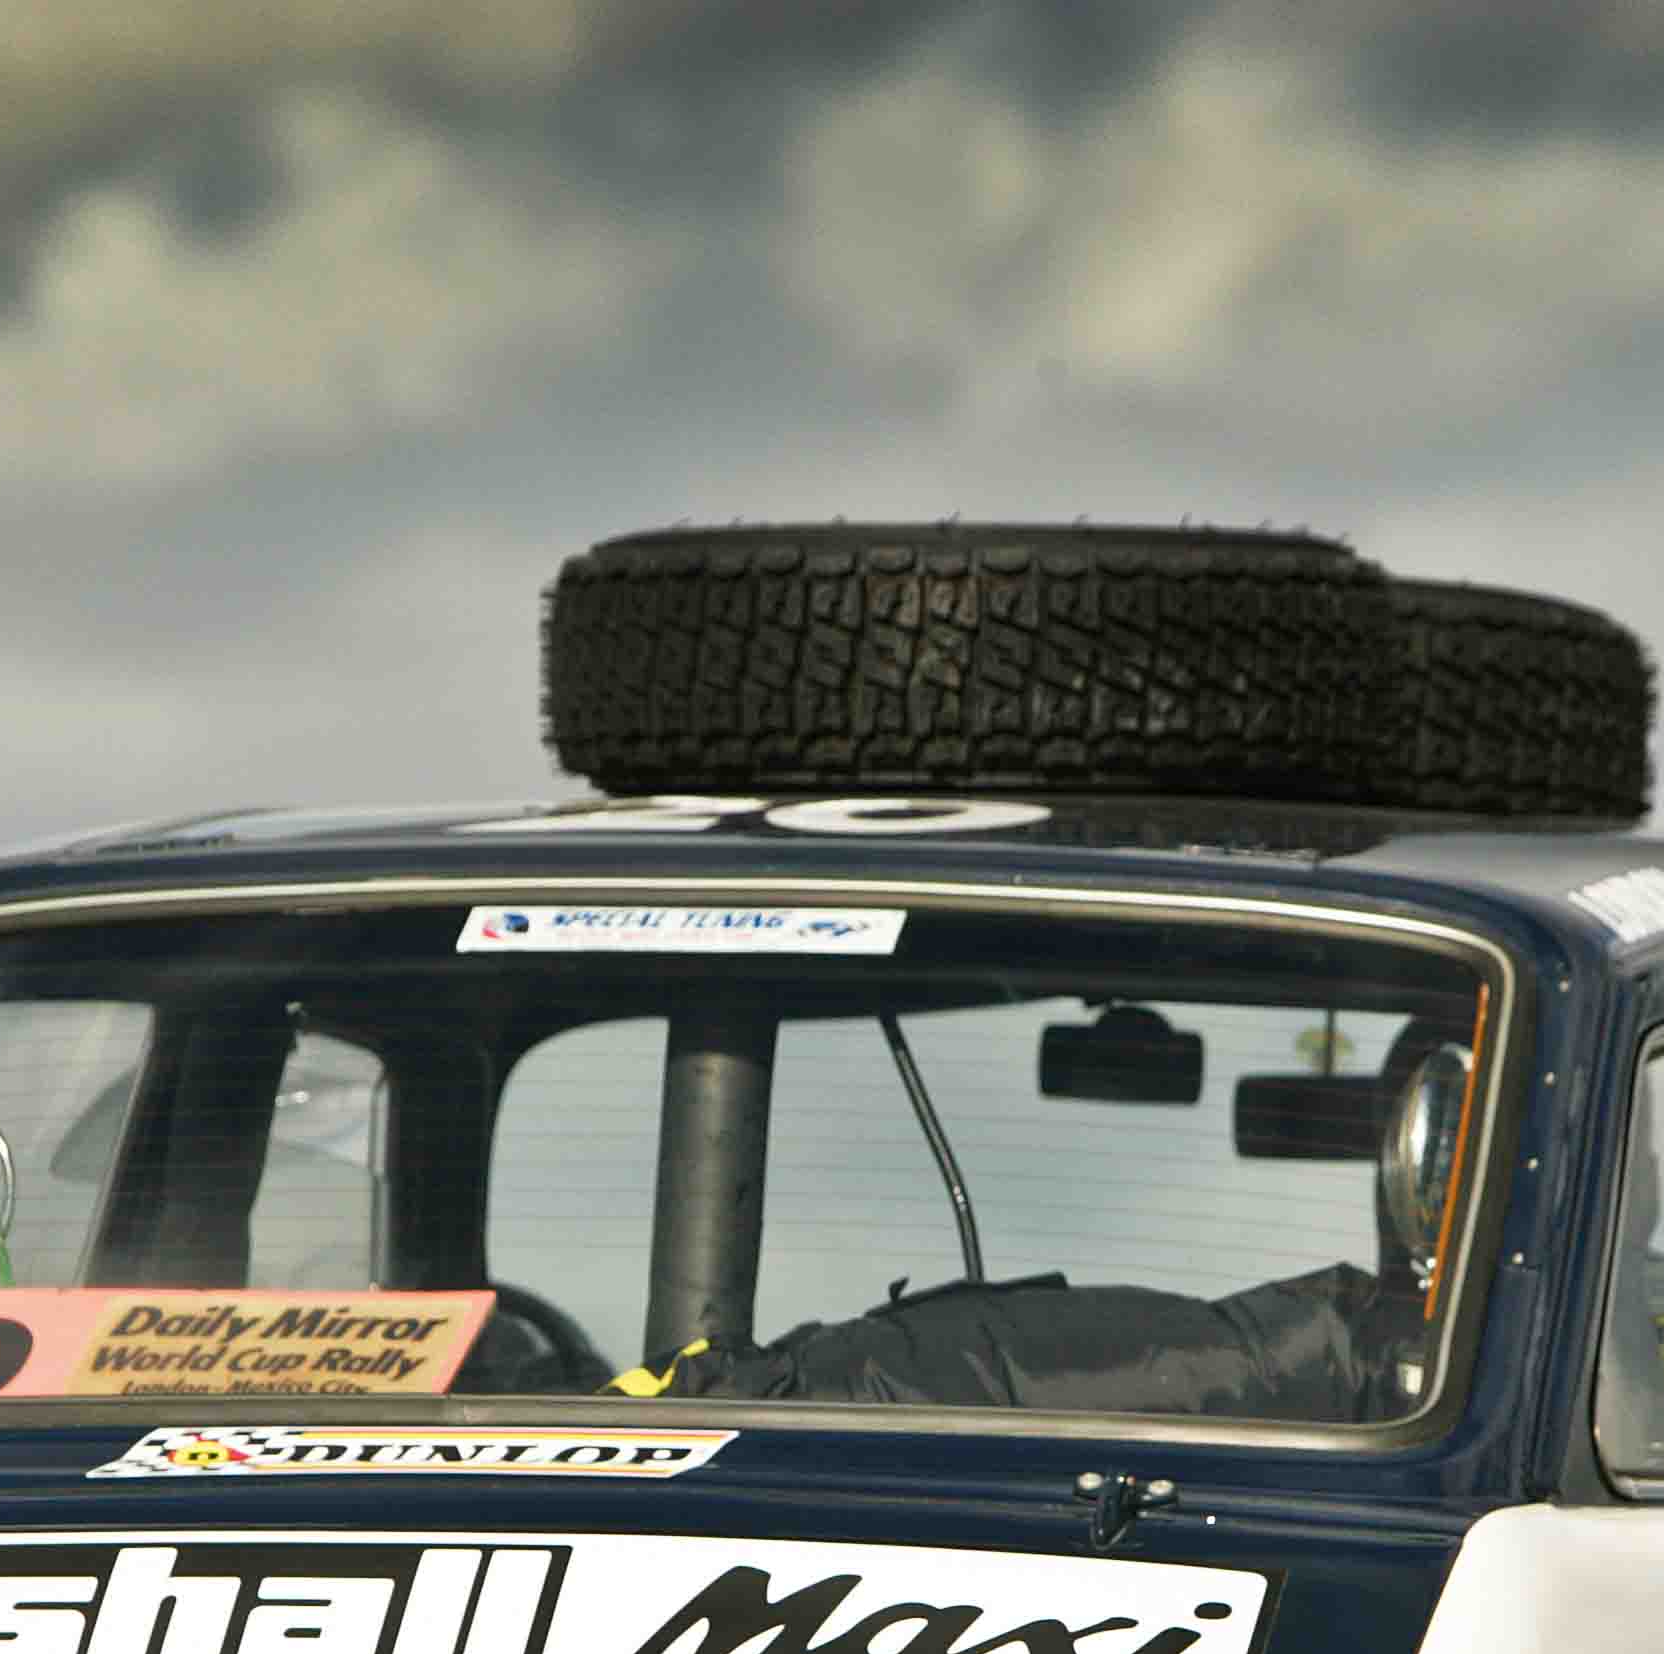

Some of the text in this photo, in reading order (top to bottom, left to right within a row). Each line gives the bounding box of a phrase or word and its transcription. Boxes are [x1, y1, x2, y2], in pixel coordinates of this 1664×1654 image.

[110, 1305, 448, 1343] Daily Mirror
[91, 1345, 428, 1379] World Cup Rally
[272, 1443, 695, 1465] DUNLOP
